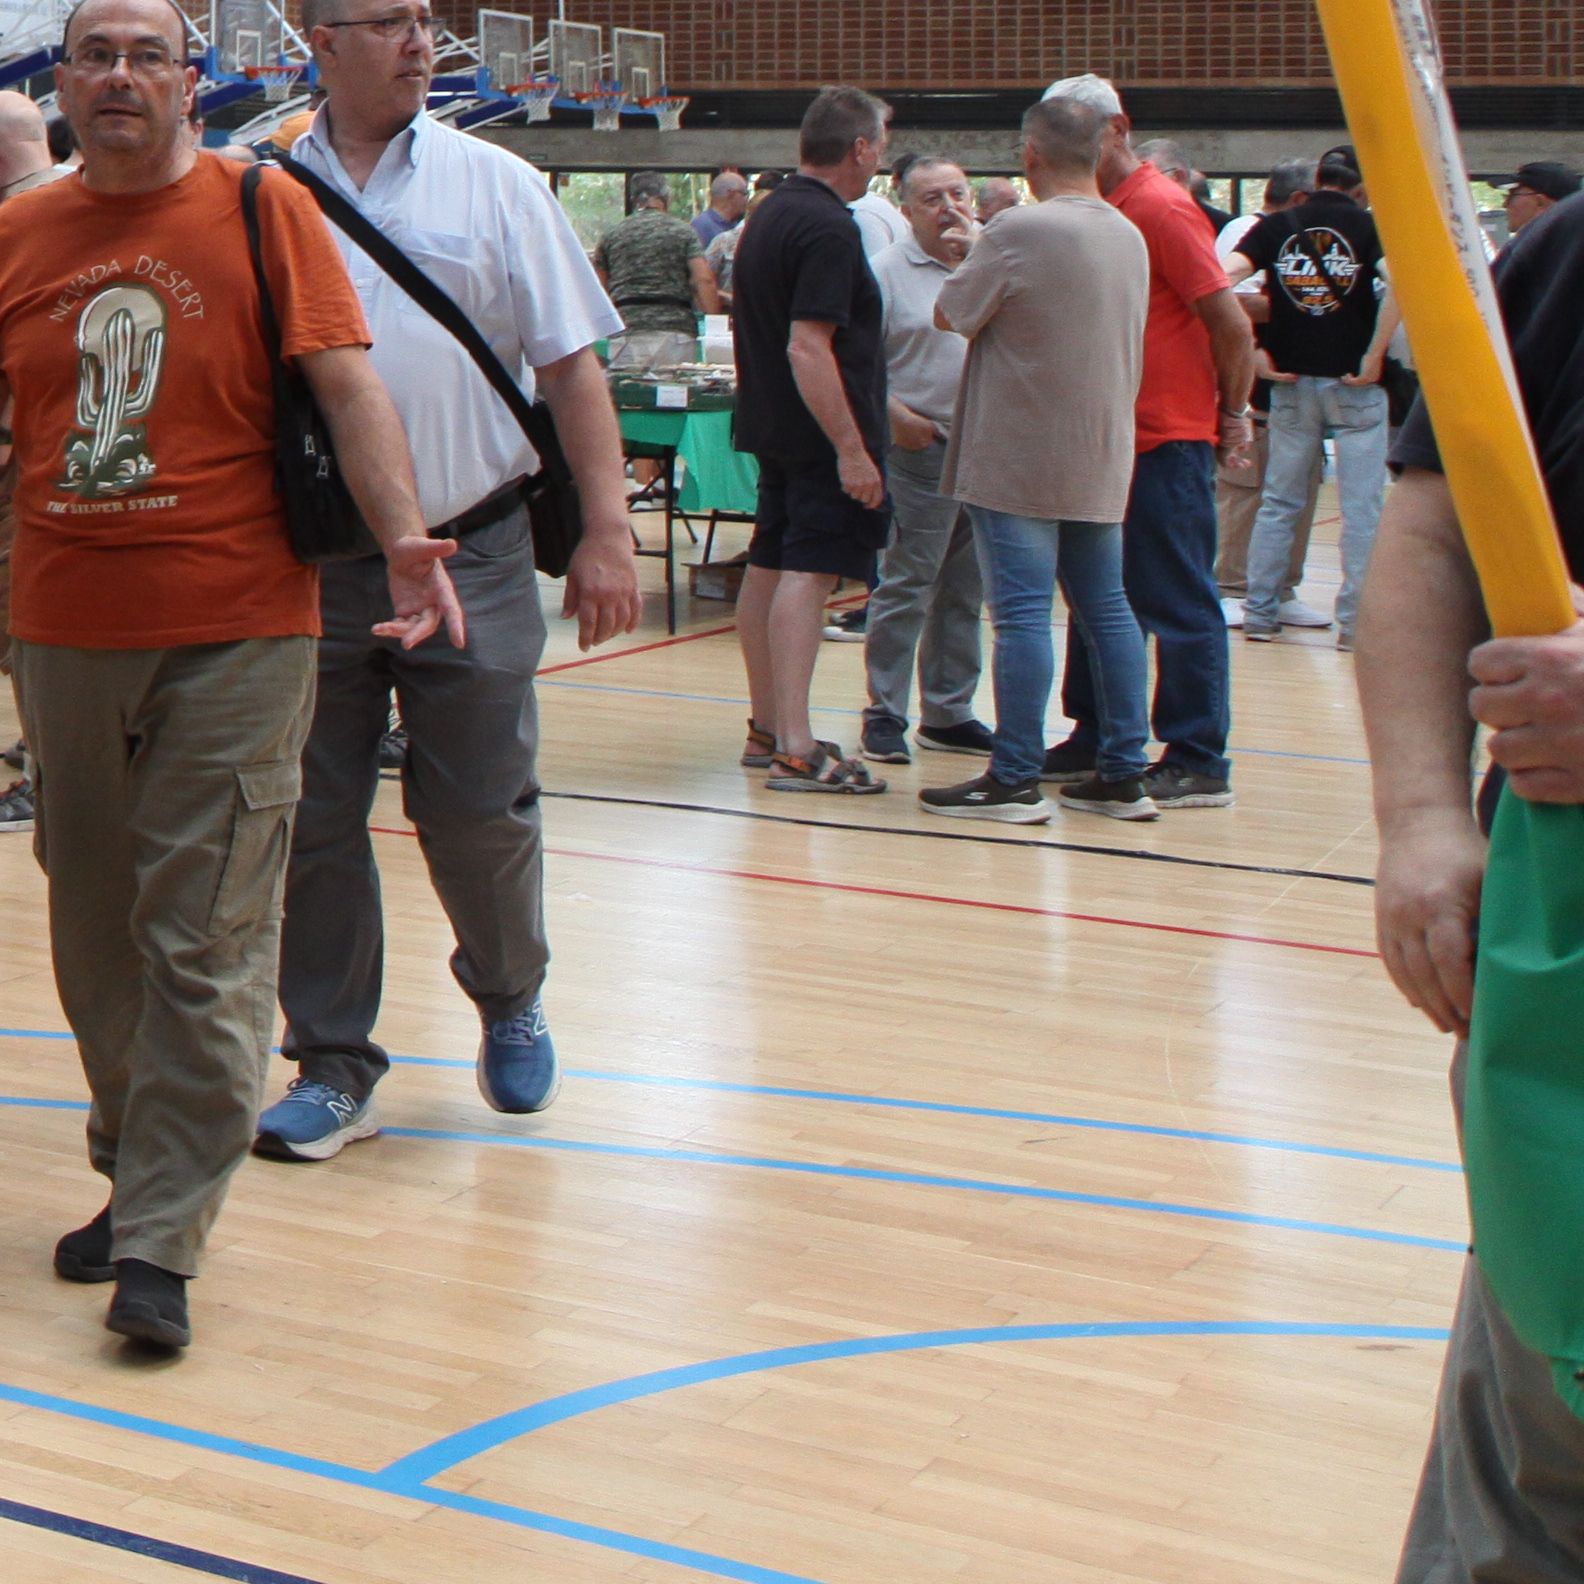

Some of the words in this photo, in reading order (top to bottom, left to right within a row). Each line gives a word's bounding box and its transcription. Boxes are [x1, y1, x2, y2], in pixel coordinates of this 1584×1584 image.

[50, 259, 122, 323] NEVADA
[134, 255, 205, 320] DESERT
[70, 499, 125, 514] SILVER
[128, 495, 178, 511] STATE
